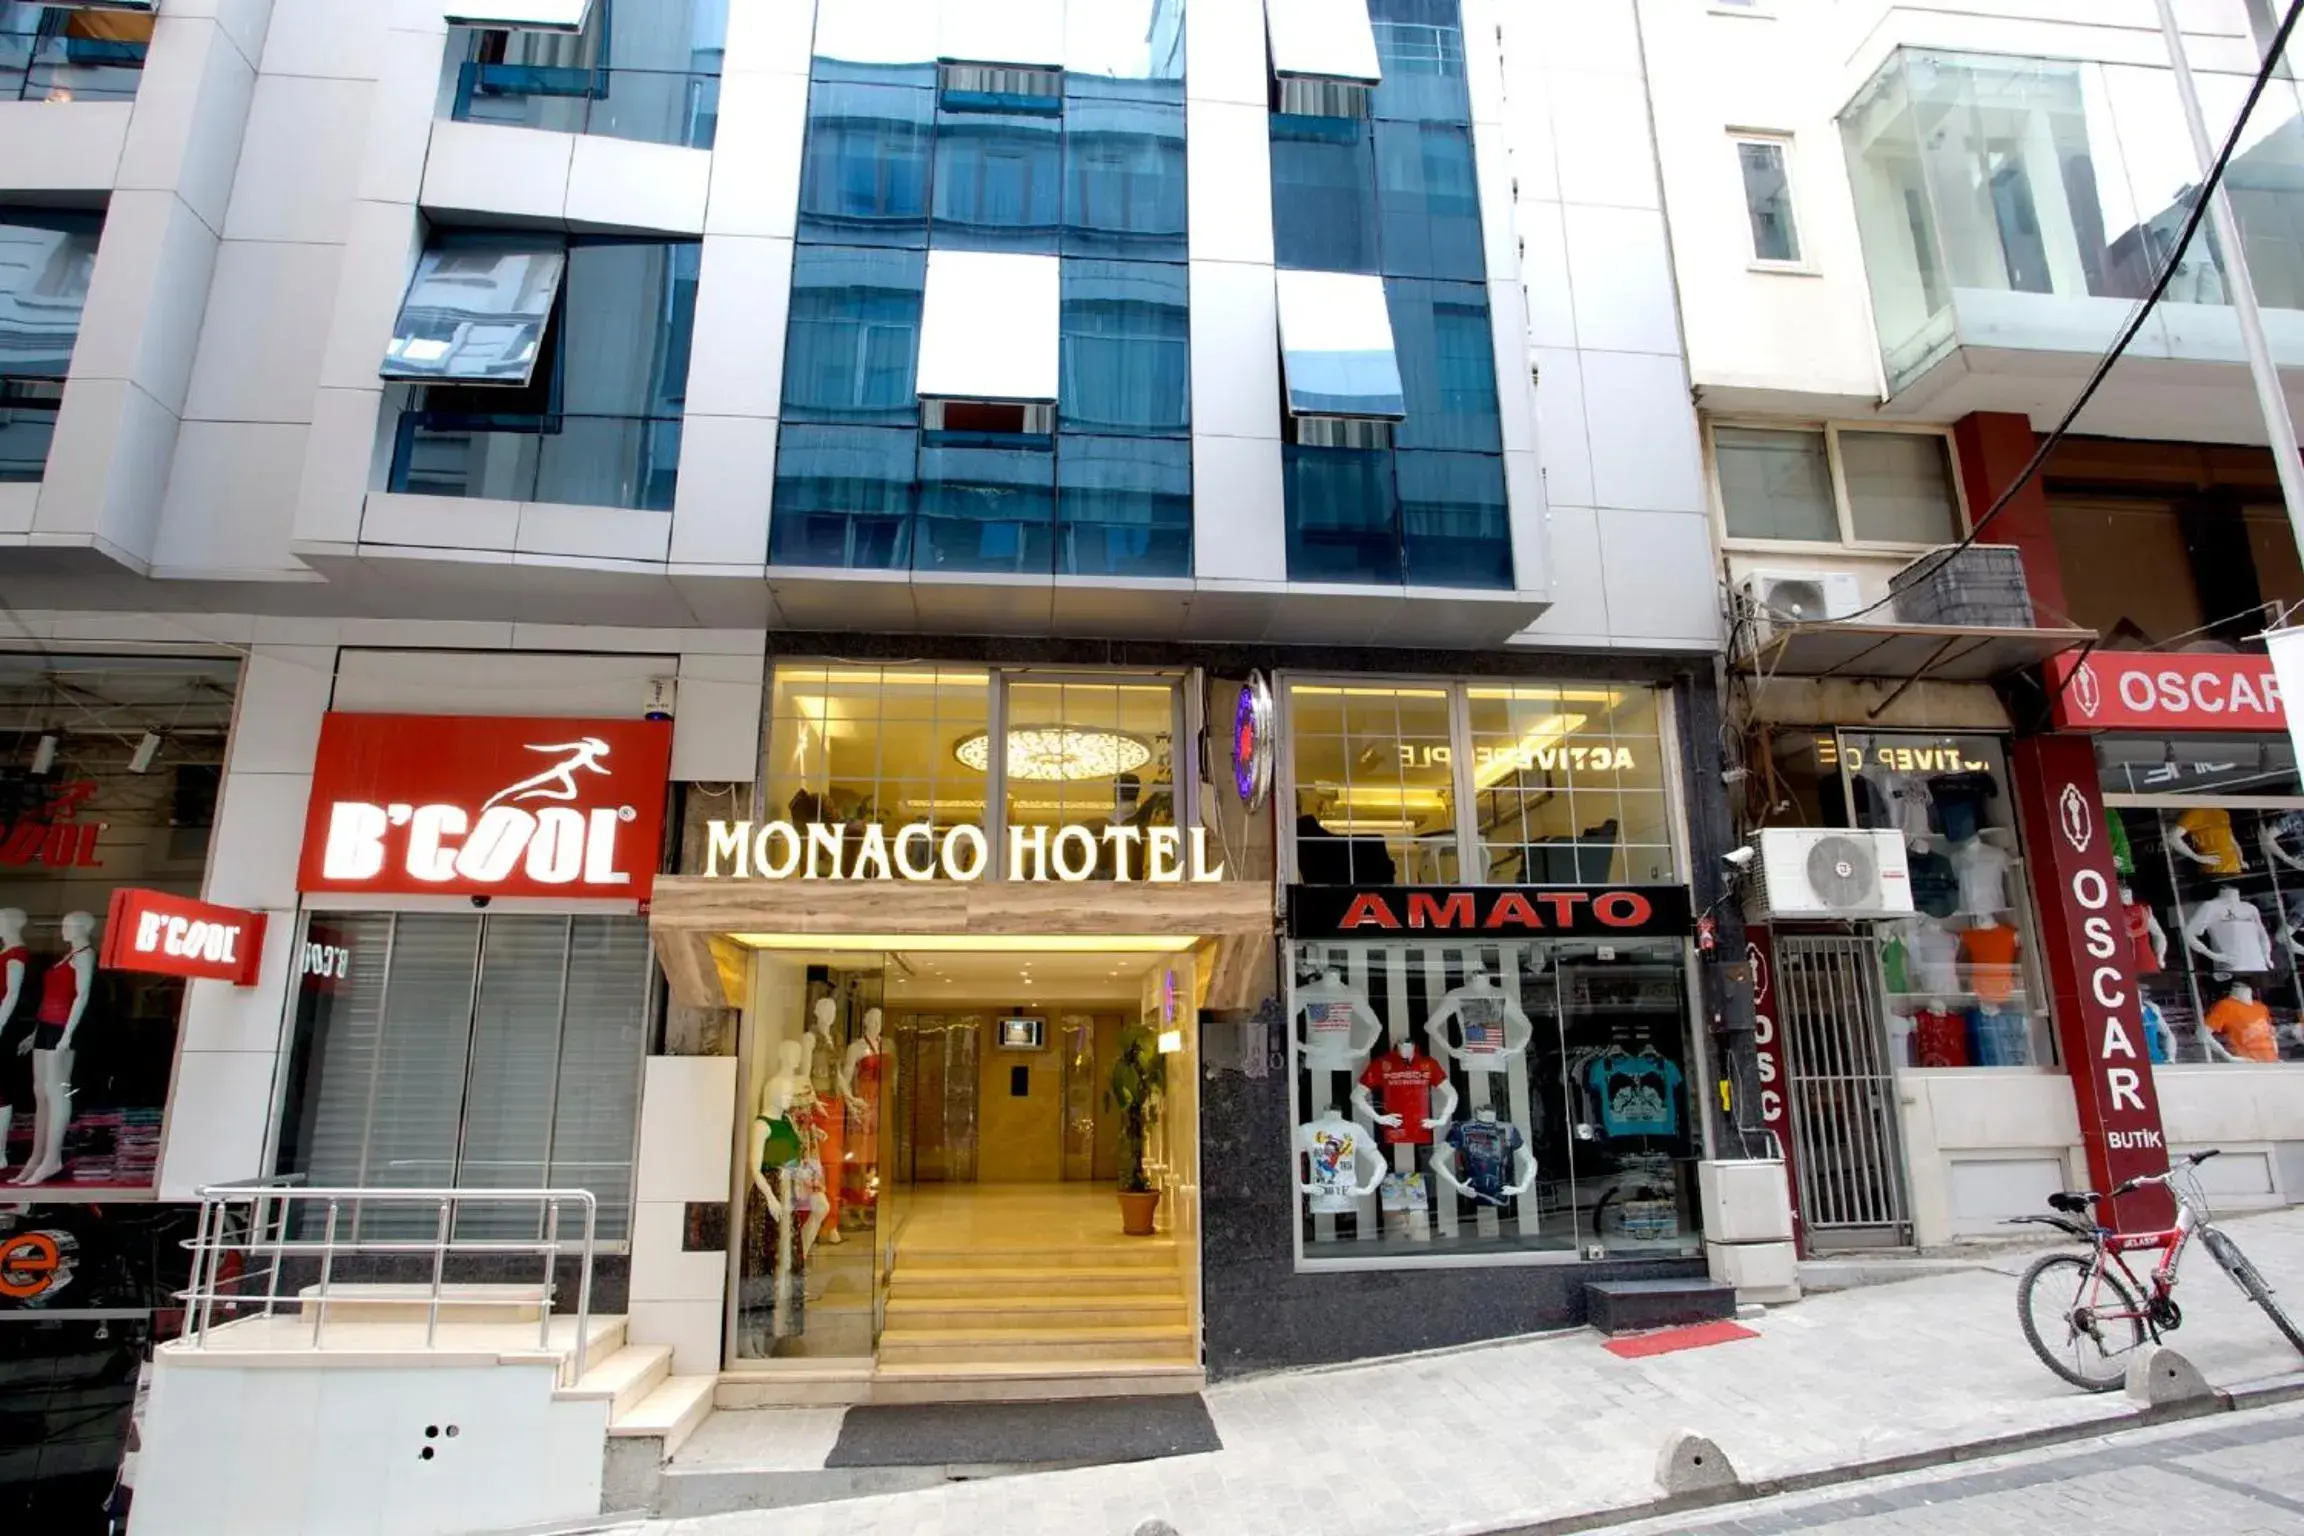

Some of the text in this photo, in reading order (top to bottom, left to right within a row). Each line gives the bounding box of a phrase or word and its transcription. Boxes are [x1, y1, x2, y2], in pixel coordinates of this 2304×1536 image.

[703, 820, 1224, 882] MONACO HOTEL
[1338, 891, 1653, 929] AMATO
[2072, 868, 2146, 1111] OSCAR
[2108, 1130, 2163, 1149] BUTİK
